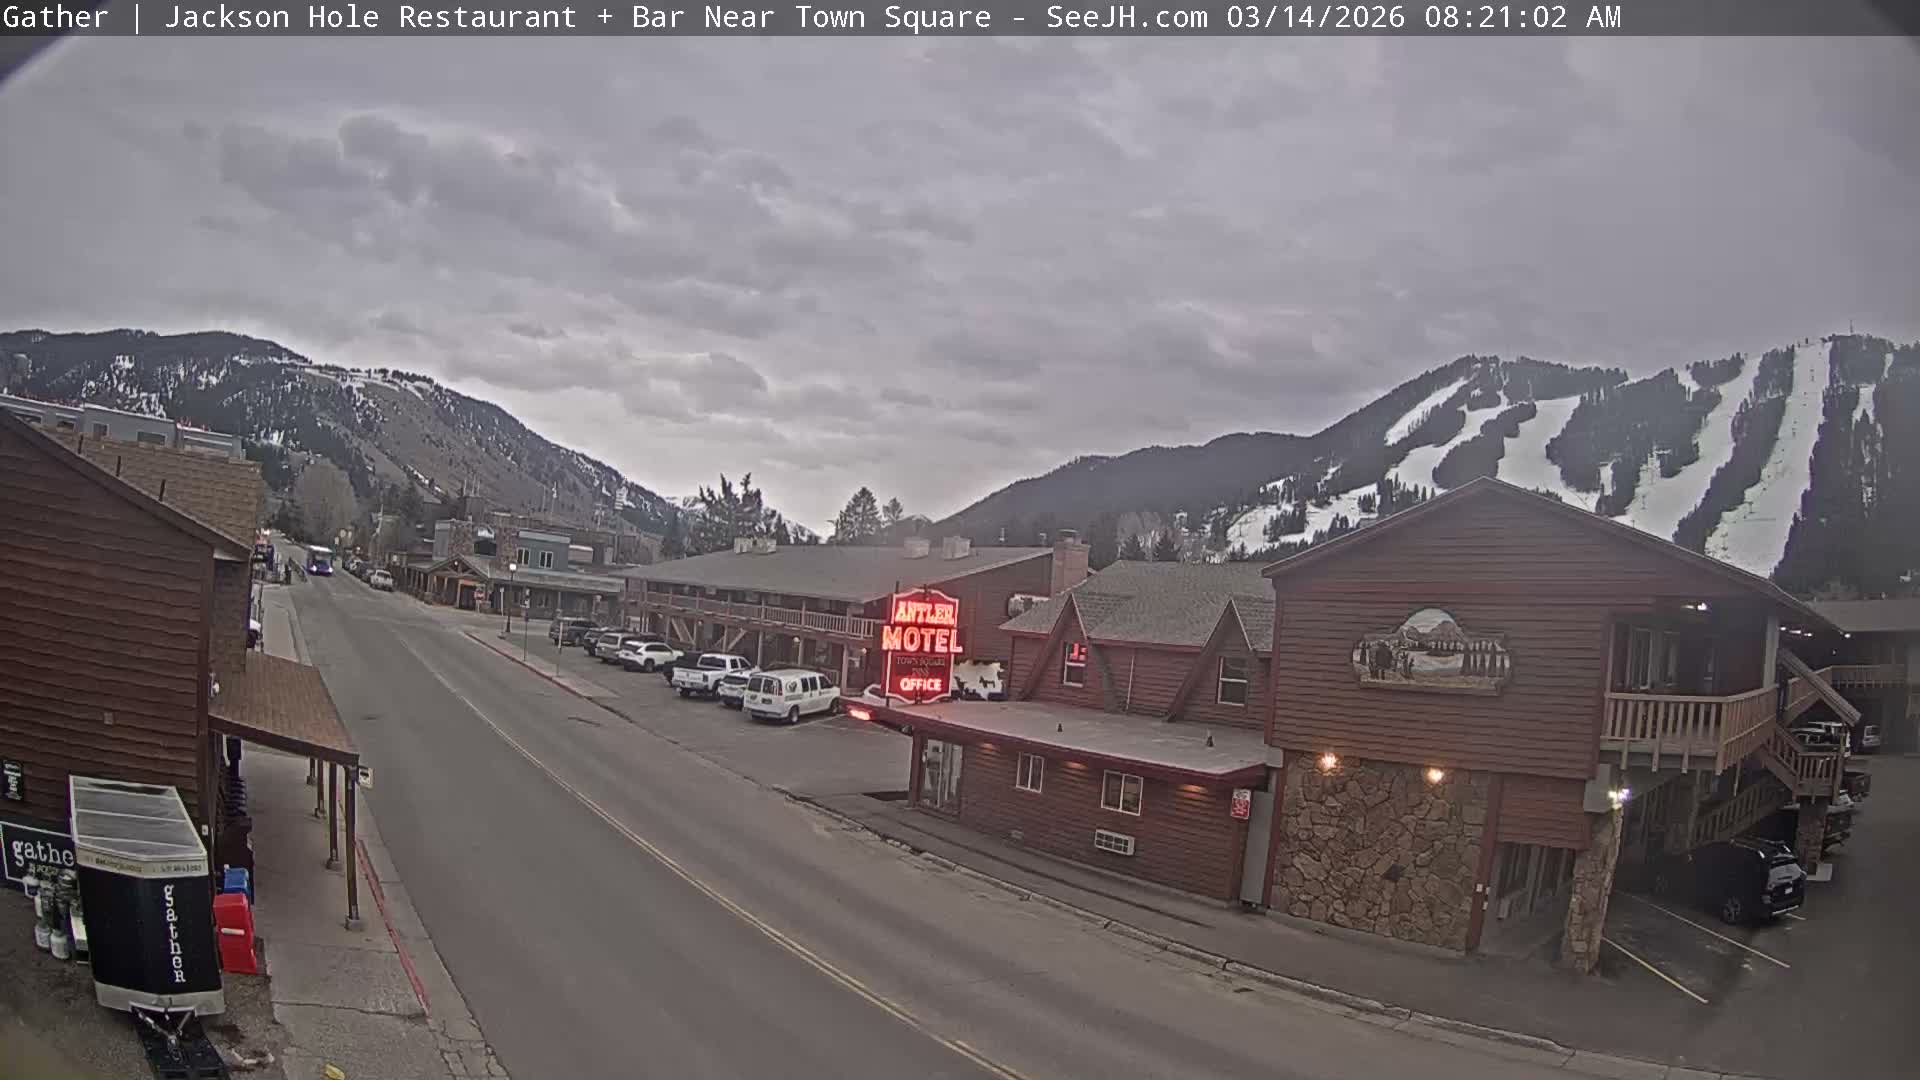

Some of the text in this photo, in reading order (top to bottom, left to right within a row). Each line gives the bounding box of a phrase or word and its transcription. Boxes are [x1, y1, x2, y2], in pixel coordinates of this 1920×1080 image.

[895, 601, 955, 625] ANTLER
[882, 626, 963, 653] MOTEL
[899, 677, 942, 692] OFFICE
[12, 839, 74, 868] gathe
[163, 883, 187, 983] gather
